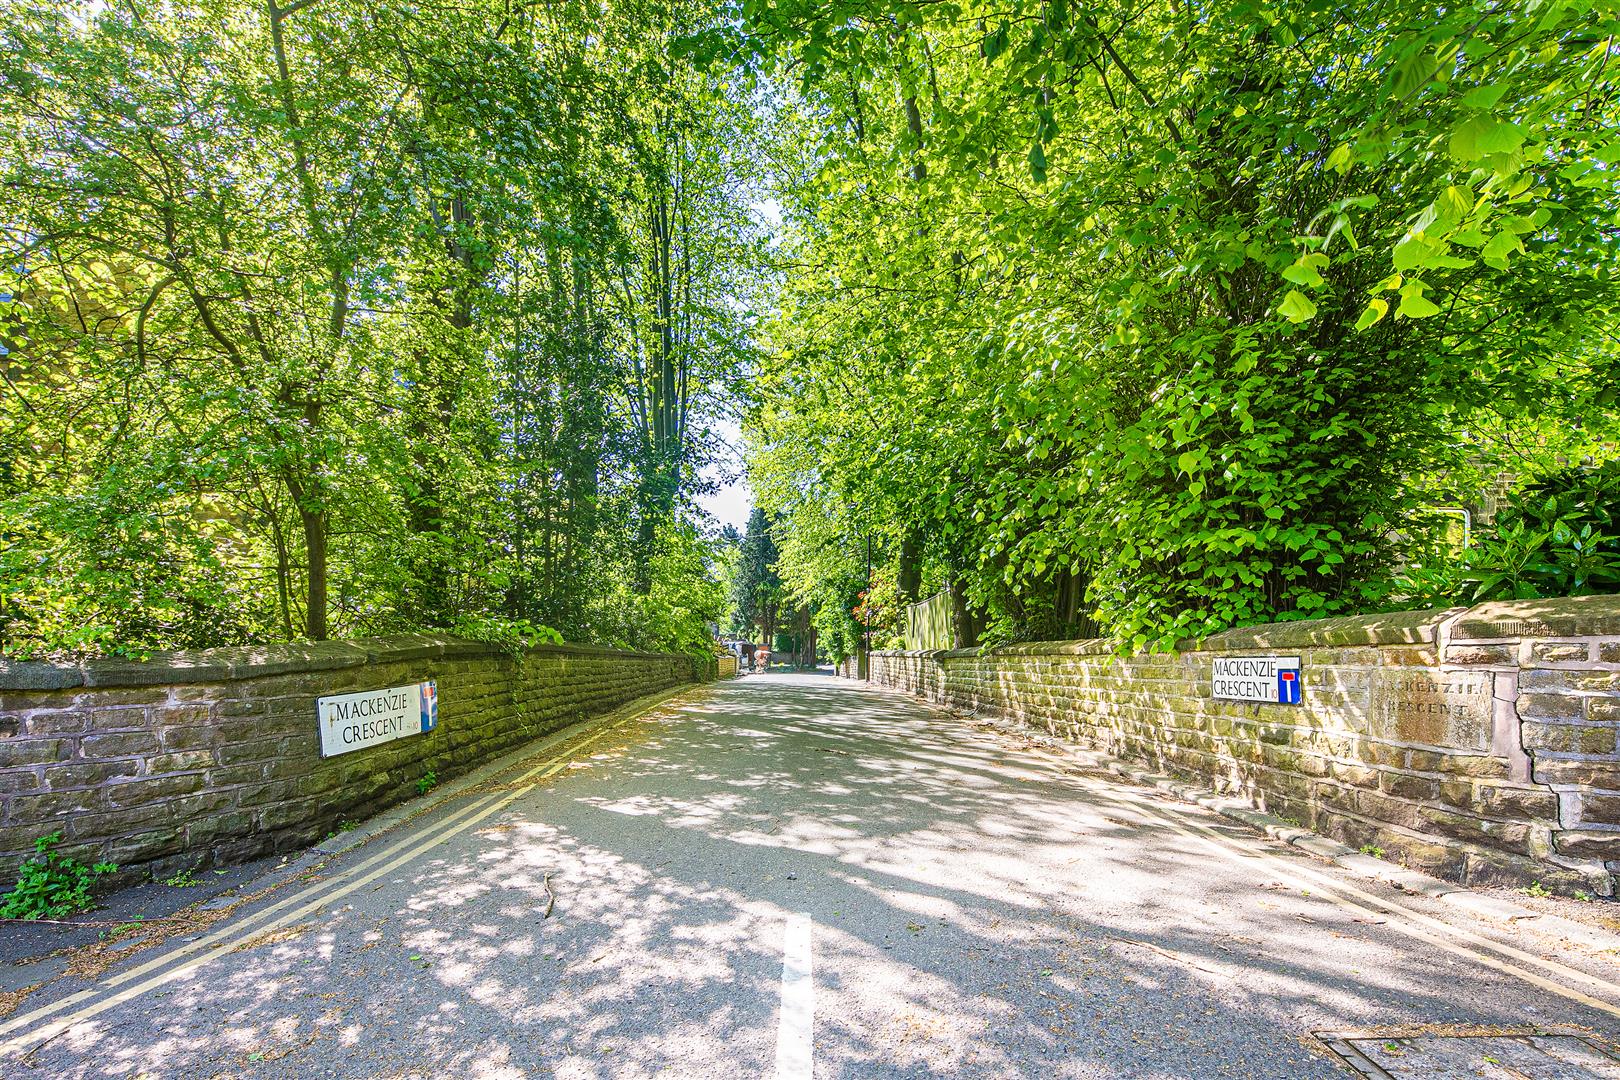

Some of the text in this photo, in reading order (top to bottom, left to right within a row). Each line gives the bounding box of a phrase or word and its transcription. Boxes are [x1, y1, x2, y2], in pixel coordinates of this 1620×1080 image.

[1213, 660, 1277, 678] MACKENZIE
[1213, 680, 1270, 698] CRESCENT
[1382, 679, 1478, 695] CKENZIE
[335, 693, 408, 722] MACKENZIE
[1382, 700, 1468, 716] RESCENT
[342, 715, 404, 744] CRESCENT
